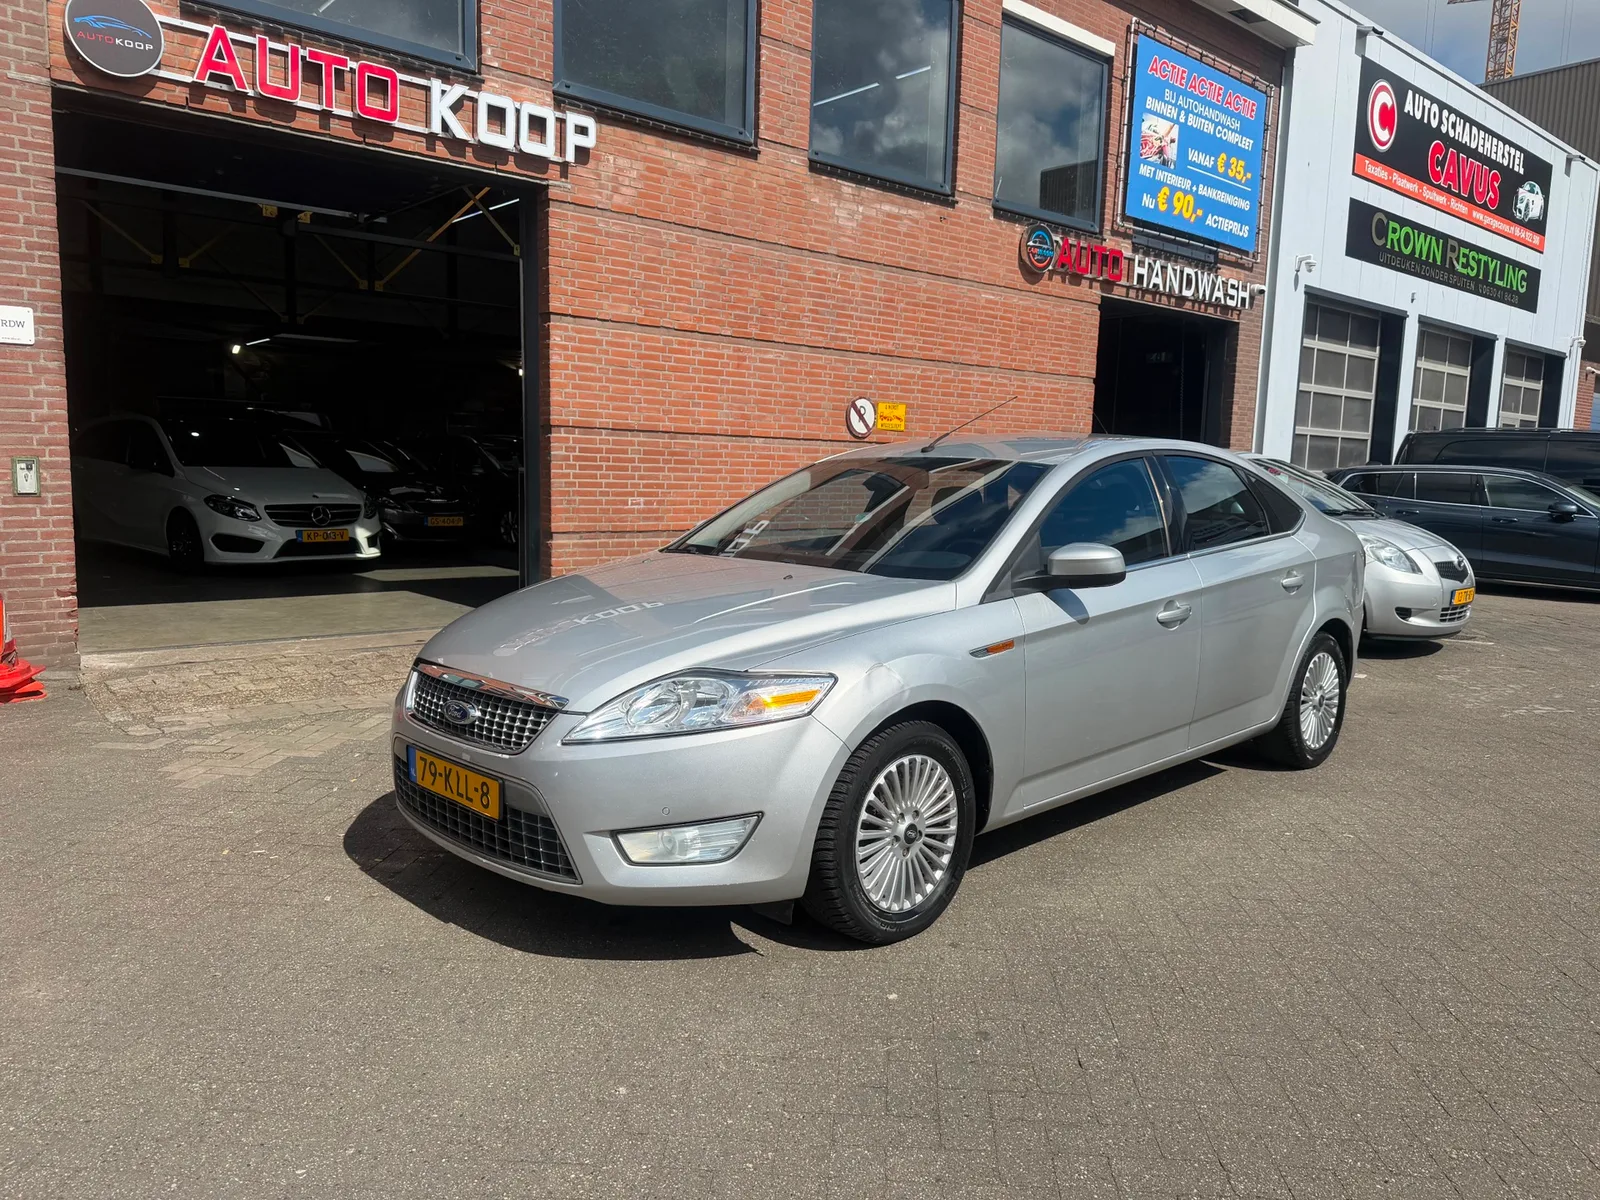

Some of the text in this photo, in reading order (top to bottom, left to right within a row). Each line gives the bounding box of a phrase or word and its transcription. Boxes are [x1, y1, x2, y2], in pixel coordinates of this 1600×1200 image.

[77, 31, 153, 51] AUTOKOOP
[193, 24, 597, 164] AUTO KOOP
[1148, 55, 1258, 120] ACTIE ACTIE ACTIE
[1164, 89, 1240, 131] BIJ AUTOHANDWASH
[1146, 96, 1254, 151] BINNEN & BUITEN COMPLEET
[1404, 90, 1525, 175] AUTO SCHADEHERSTEL
[1139, 163, 1250, 211] MET INTERIEUR + BANKREINIGING
[1188, 147, 1252, 183] VANAF € 35,-
[1365, 160, 1388, 180] Taxaties
[1392, 173, 1418, 193] Plaatwerk
[1422, 186, 1447, 206] Spuitwerk
[1450, 198, 1468, 215] Richten
[1428, 140, 1501, 210] CAVUS
[1157, 186, 1170, 211] €
[1173, 190, 1203, 223] 90,-
[1205, 213, 1250, 238] ACTIEPRIJS
[1057, 237, 1250, 309] AUTO HANDWASH
[1371, 211, 1528, 293] CROWN RESTYLING
[1379, 252, 1421, 274] UITDEUKEN
[1421, 265, 1448, 281] ZONDER
[1449, 274, 1475, 291] SPUITEN
[1, 319, 25, 328] RDW
[420, 756, 490, 810] 79-KLL-8
